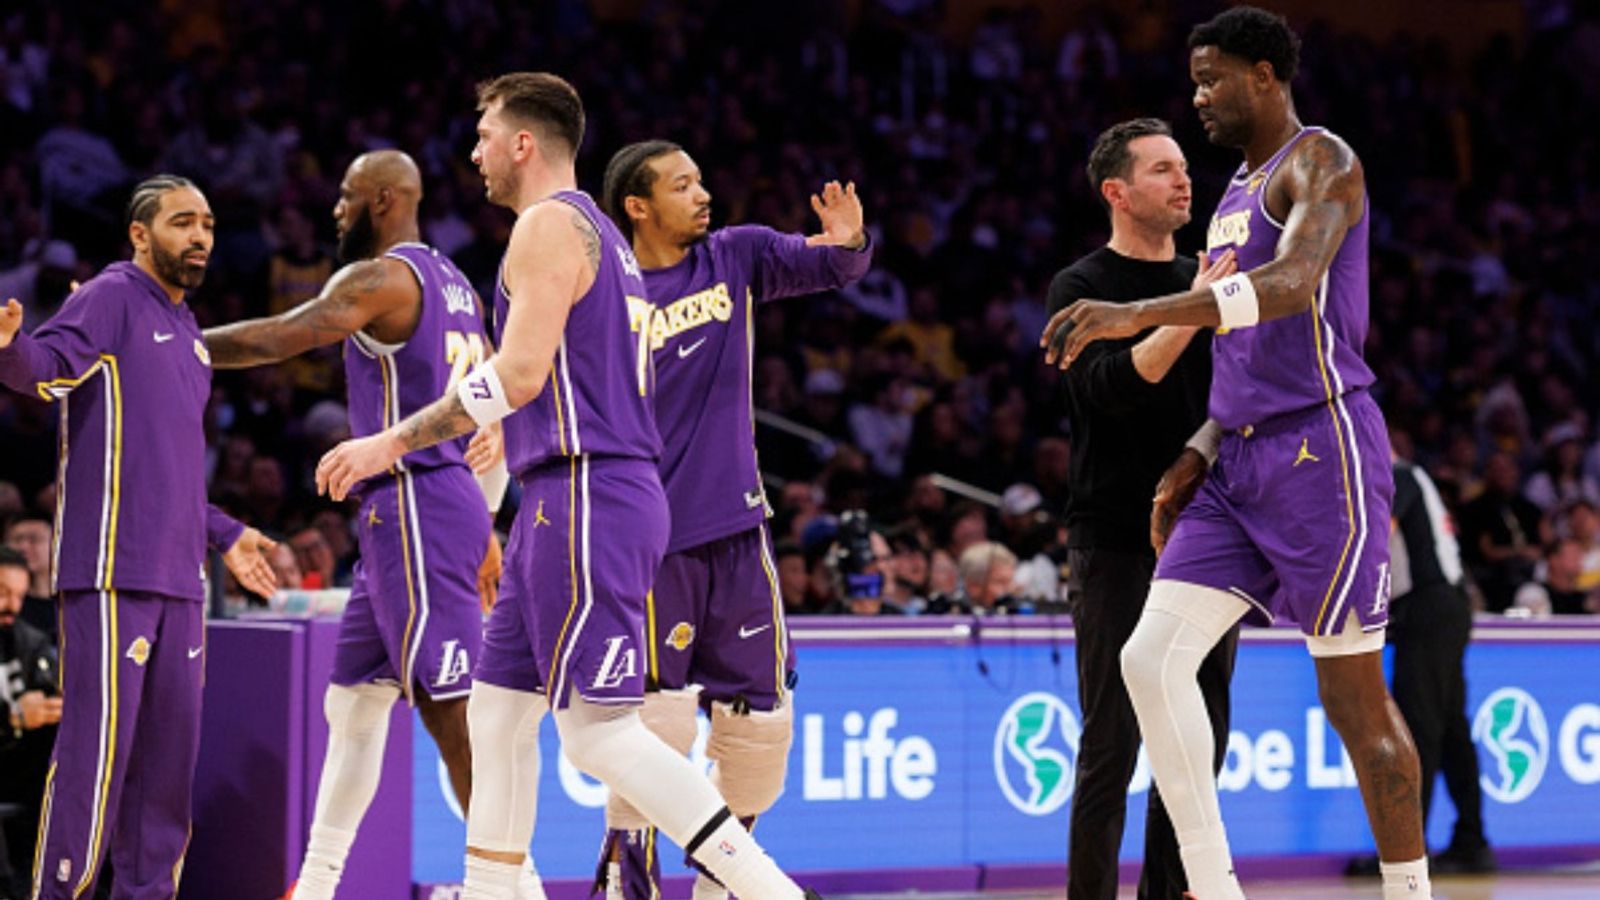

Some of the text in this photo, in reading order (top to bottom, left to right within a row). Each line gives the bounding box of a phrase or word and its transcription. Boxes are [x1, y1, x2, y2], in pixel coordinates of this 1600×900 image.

[648, 282, 733, 350] AKERS
[469, 377, 493, 399] 77
[433, 640, 470, 688] LA
[590, 635, 637, 689] LA
[803, 707, 937, 800] Life
